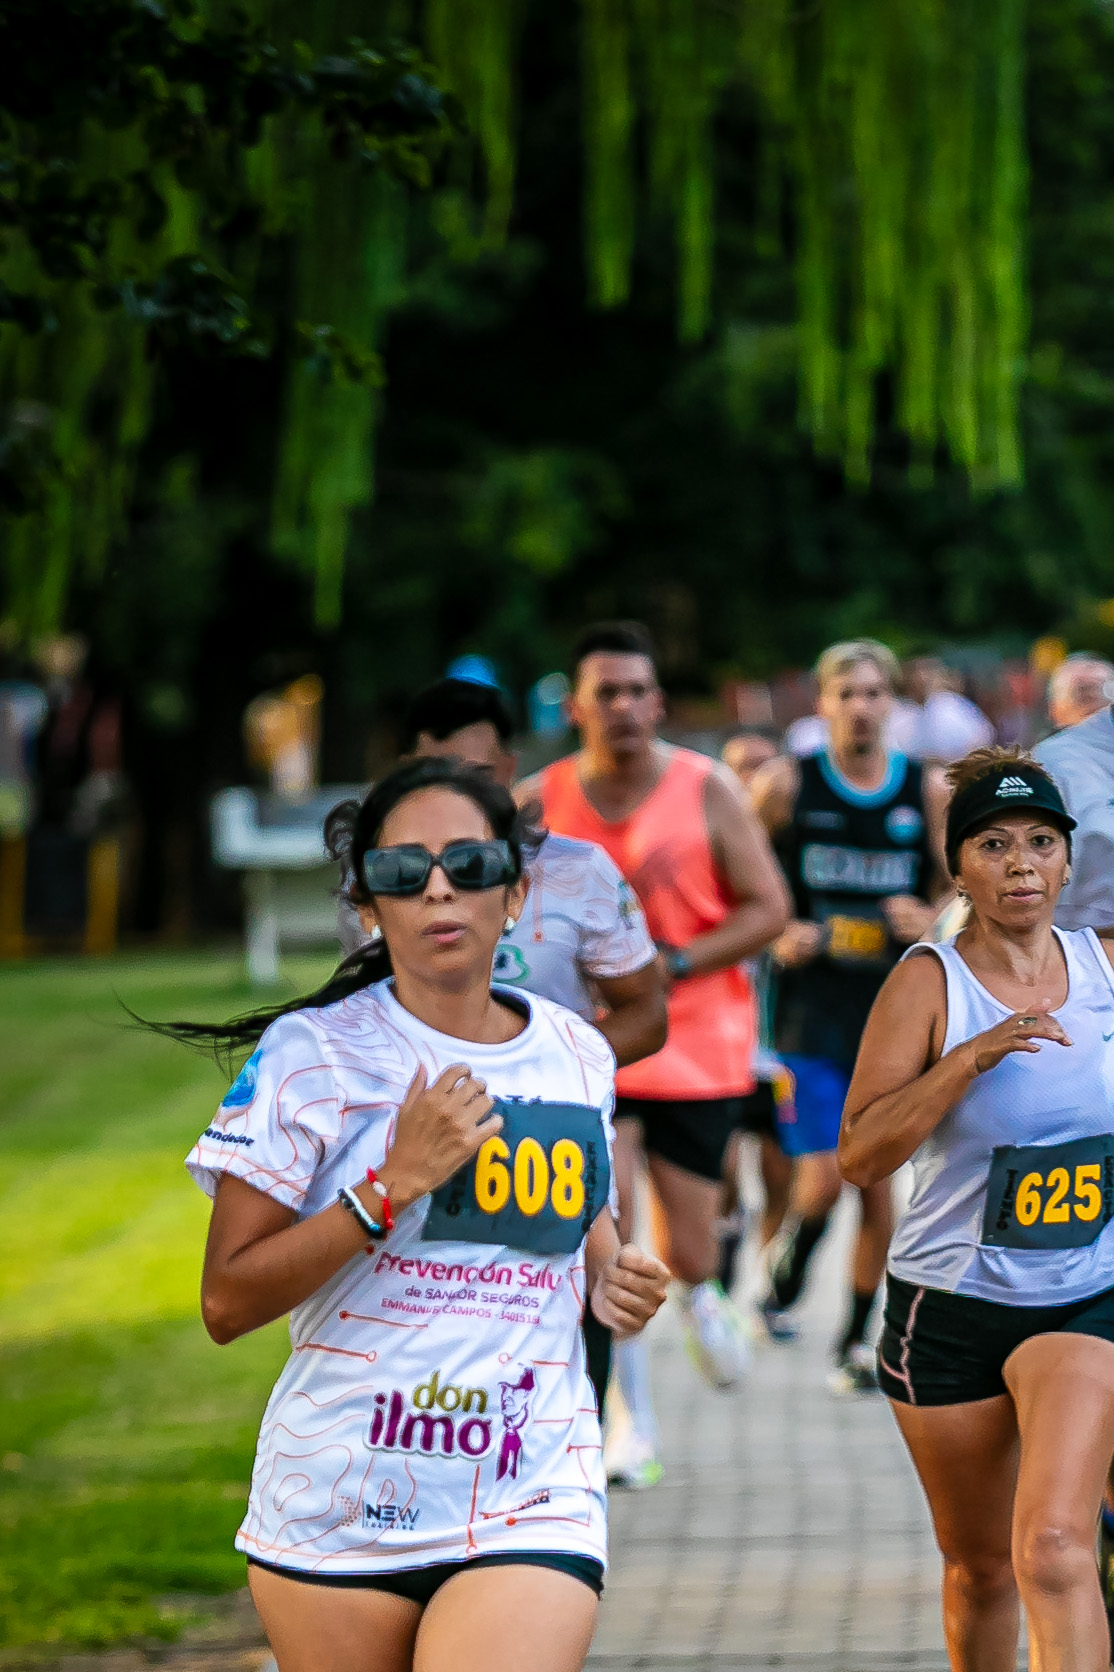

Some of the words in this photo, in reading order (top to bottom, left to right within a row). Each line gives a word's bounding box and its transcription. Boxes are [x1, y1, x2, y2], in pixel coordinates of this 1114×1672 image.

[474, 1135, 586, 1221] 608
[1014, 1163, 1103, 1226] 625
[405, 1284, 422, 1298] de
[412, 1368, 489, 1414] don
[369, 1389, 493, 1456] ilmo
[366, 1504, 420, 1524] NEW
